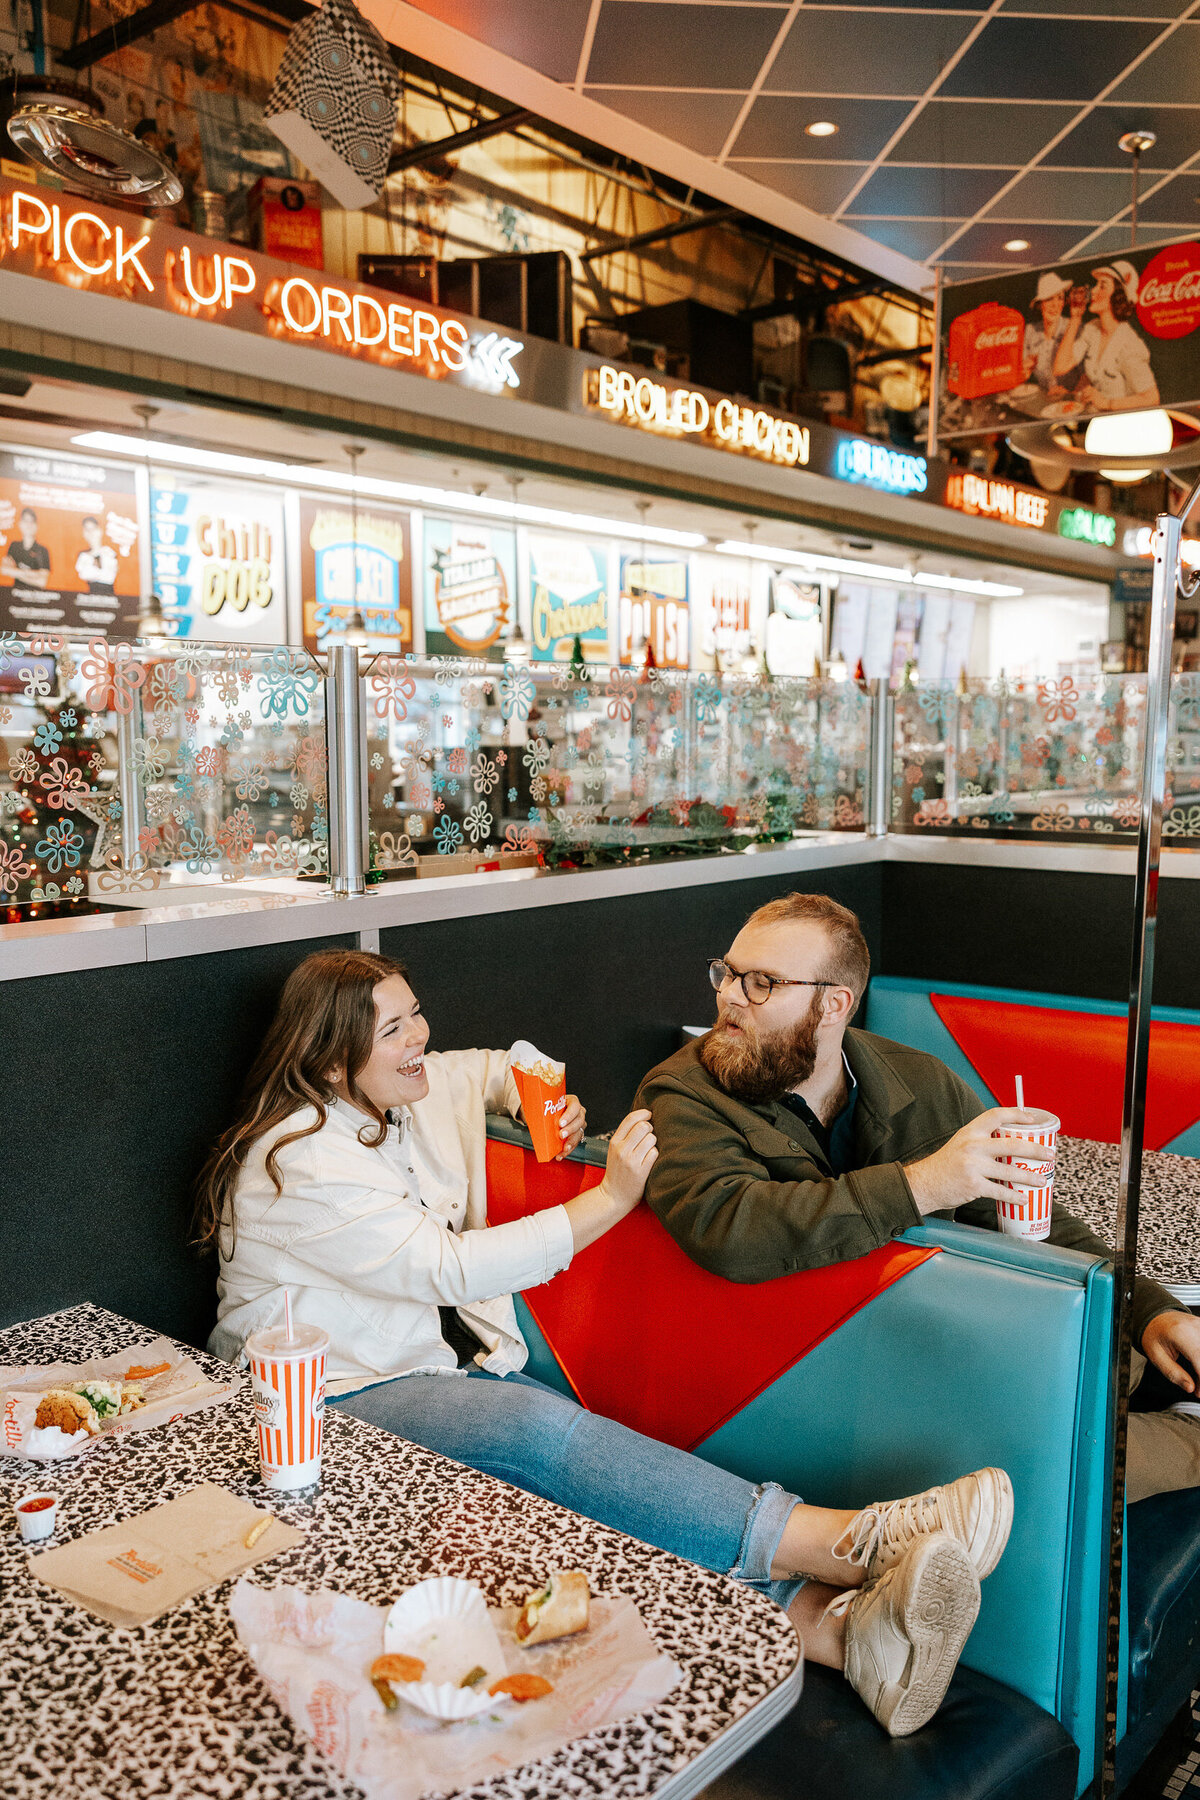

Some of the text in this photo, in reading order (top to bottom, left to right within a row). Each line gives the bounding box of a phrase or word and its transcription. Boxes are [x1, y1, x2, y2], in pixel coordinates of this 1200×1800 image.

[11, 190, 469, 372] PICK UP ORDERS
[599, 365, 809, 465] BROILED CHICKEN
[850, 439, 928, 493] BURGERS
[1016, 490, 1049, 527] BEEF
[196, 514, 272, 564] Chili
[203, 557, 272, 616] DOG
